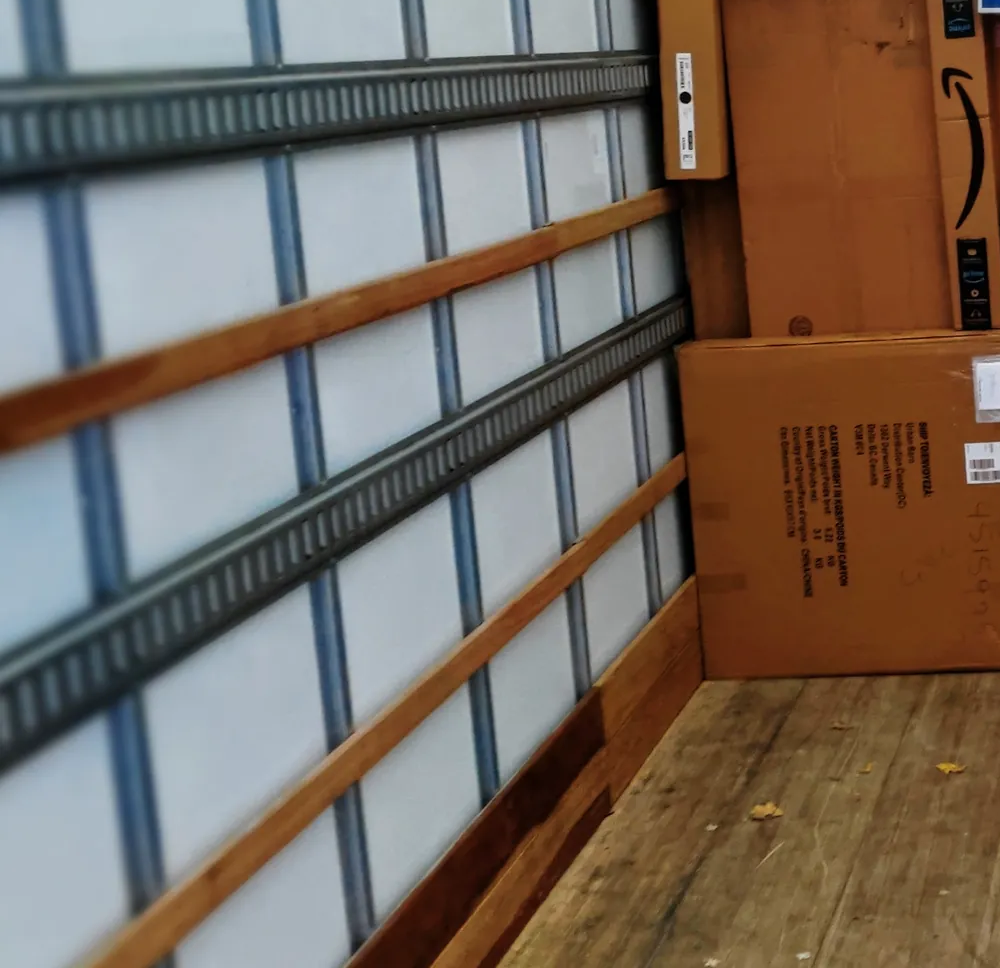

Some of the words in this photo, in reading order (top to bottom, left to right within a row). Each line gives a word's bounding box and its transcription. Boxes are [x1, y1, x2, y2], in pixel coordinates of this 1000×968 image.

[828, 425, 839, 457] CARTON
[918, 422, 928, 440] SHIP
[831, 458, 842, 488] WEIGHT
[836, 542, 846, 553] DU
[837, 554, 849, 587] CARTON
